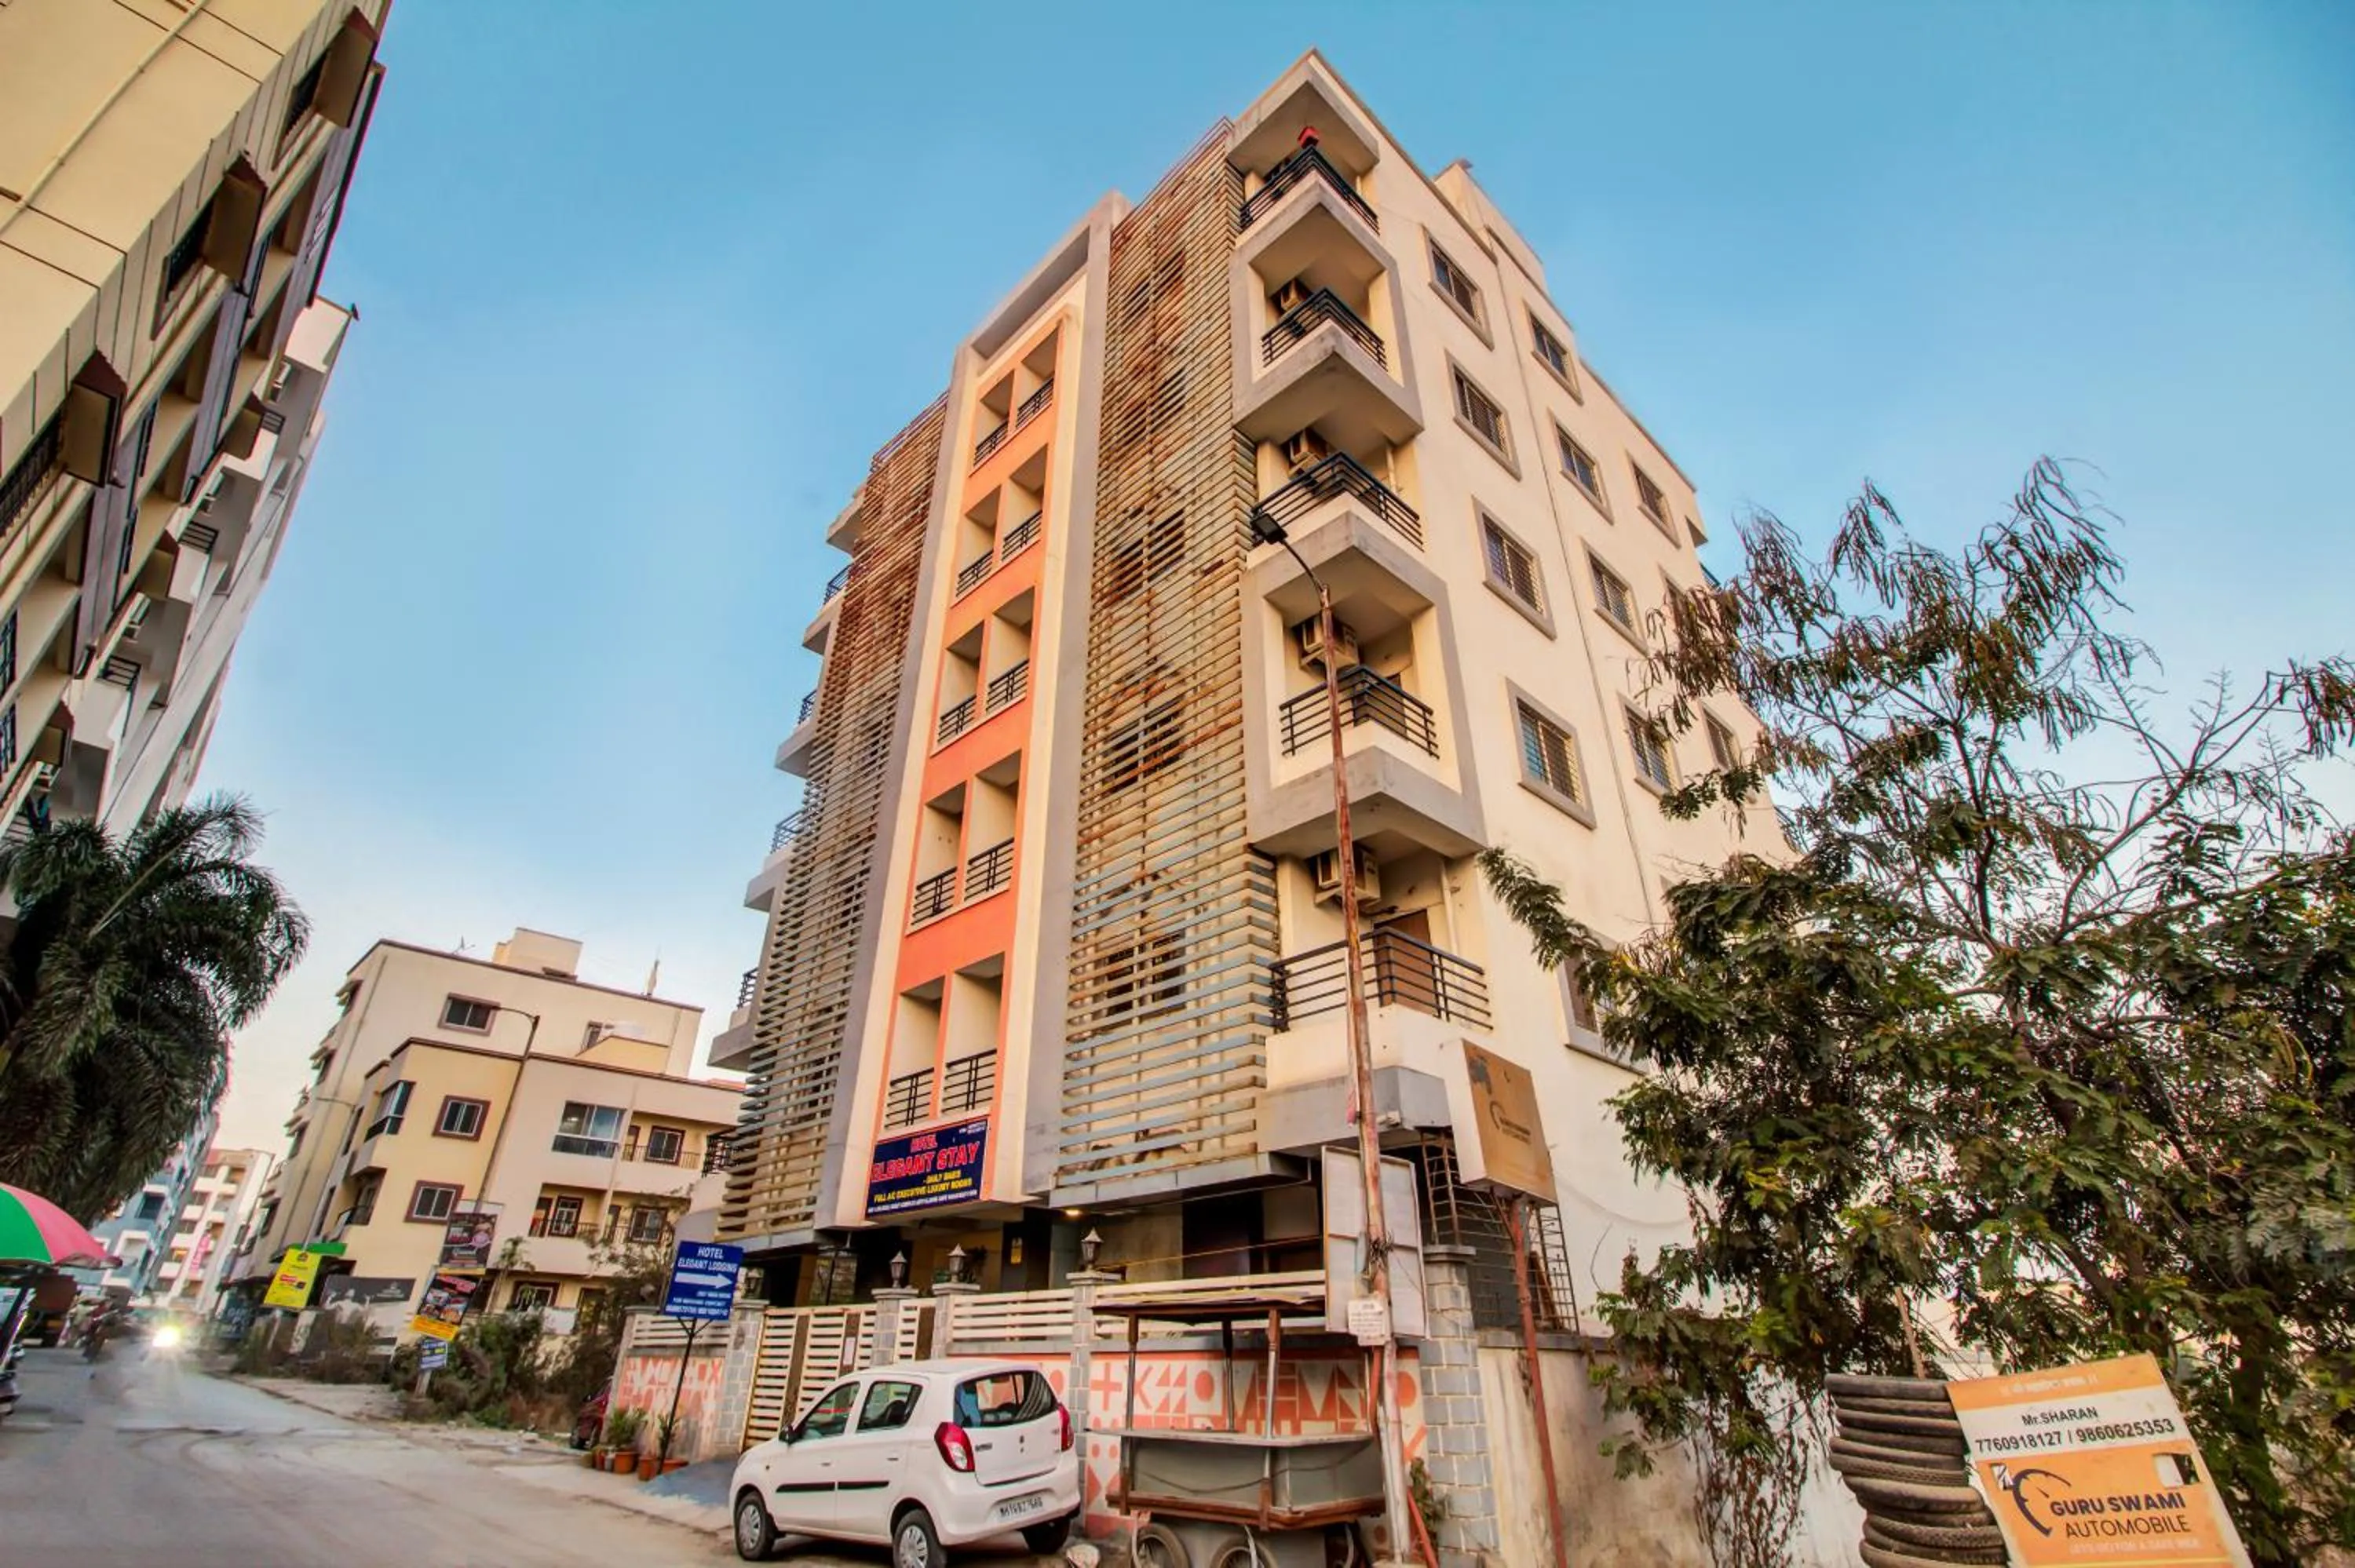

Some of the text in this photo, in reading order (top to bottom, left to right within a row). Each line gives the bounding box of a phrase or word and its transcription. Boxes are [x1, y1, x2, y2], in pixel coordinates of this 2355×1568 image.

[871, 1151, 936, 1183] ELEGANT
[937, 1141, 980, 1170] STAY
[677, 1257, 708, 1270] ELEGANT
[697, 1246, 724, 1260] HOTEL
[2021, 1406, 2098, 1427] Mr.SHARAN
[1975, 1431, 2061, 1453] 7760918127
[2077, 1418, 2175, 1442] 9860625353
[2050, 1492, 2186, 1516] GURU SWAMI
[2066, 1514, 2192, 1538] AUTOMOBILE
